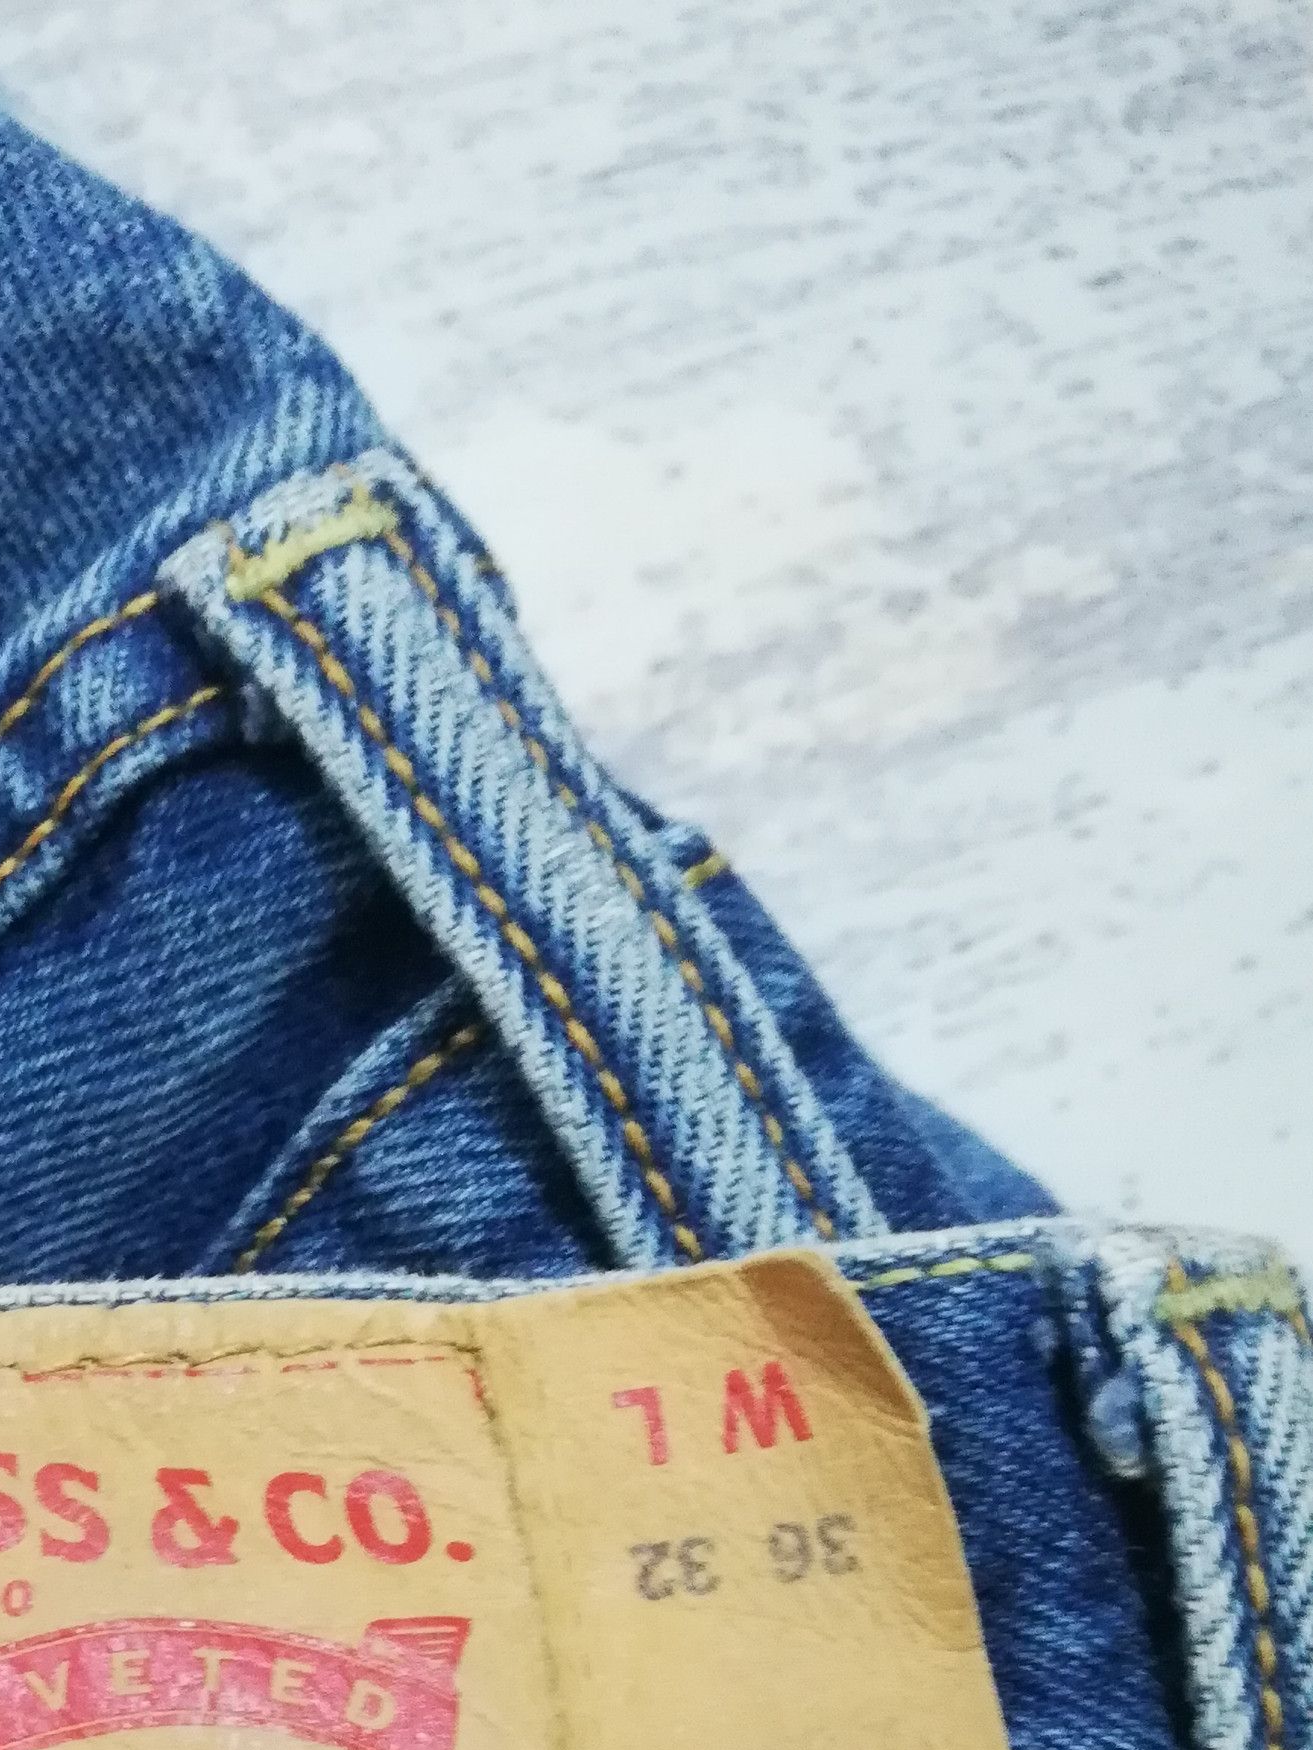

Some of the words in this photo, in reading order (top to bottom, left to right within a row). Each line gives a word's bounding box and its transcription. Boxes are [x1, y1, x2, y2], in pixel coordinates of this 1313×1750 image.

[611, 1387, 669, 1466] L
[722, 1361, 814, 1454] W
[150, 1467, 241, 1569] &
[263, 1469, 477, 1565] CO.
[767, 1513, 864, 1584] 36
[628, 1536, 721, 1602] 32
